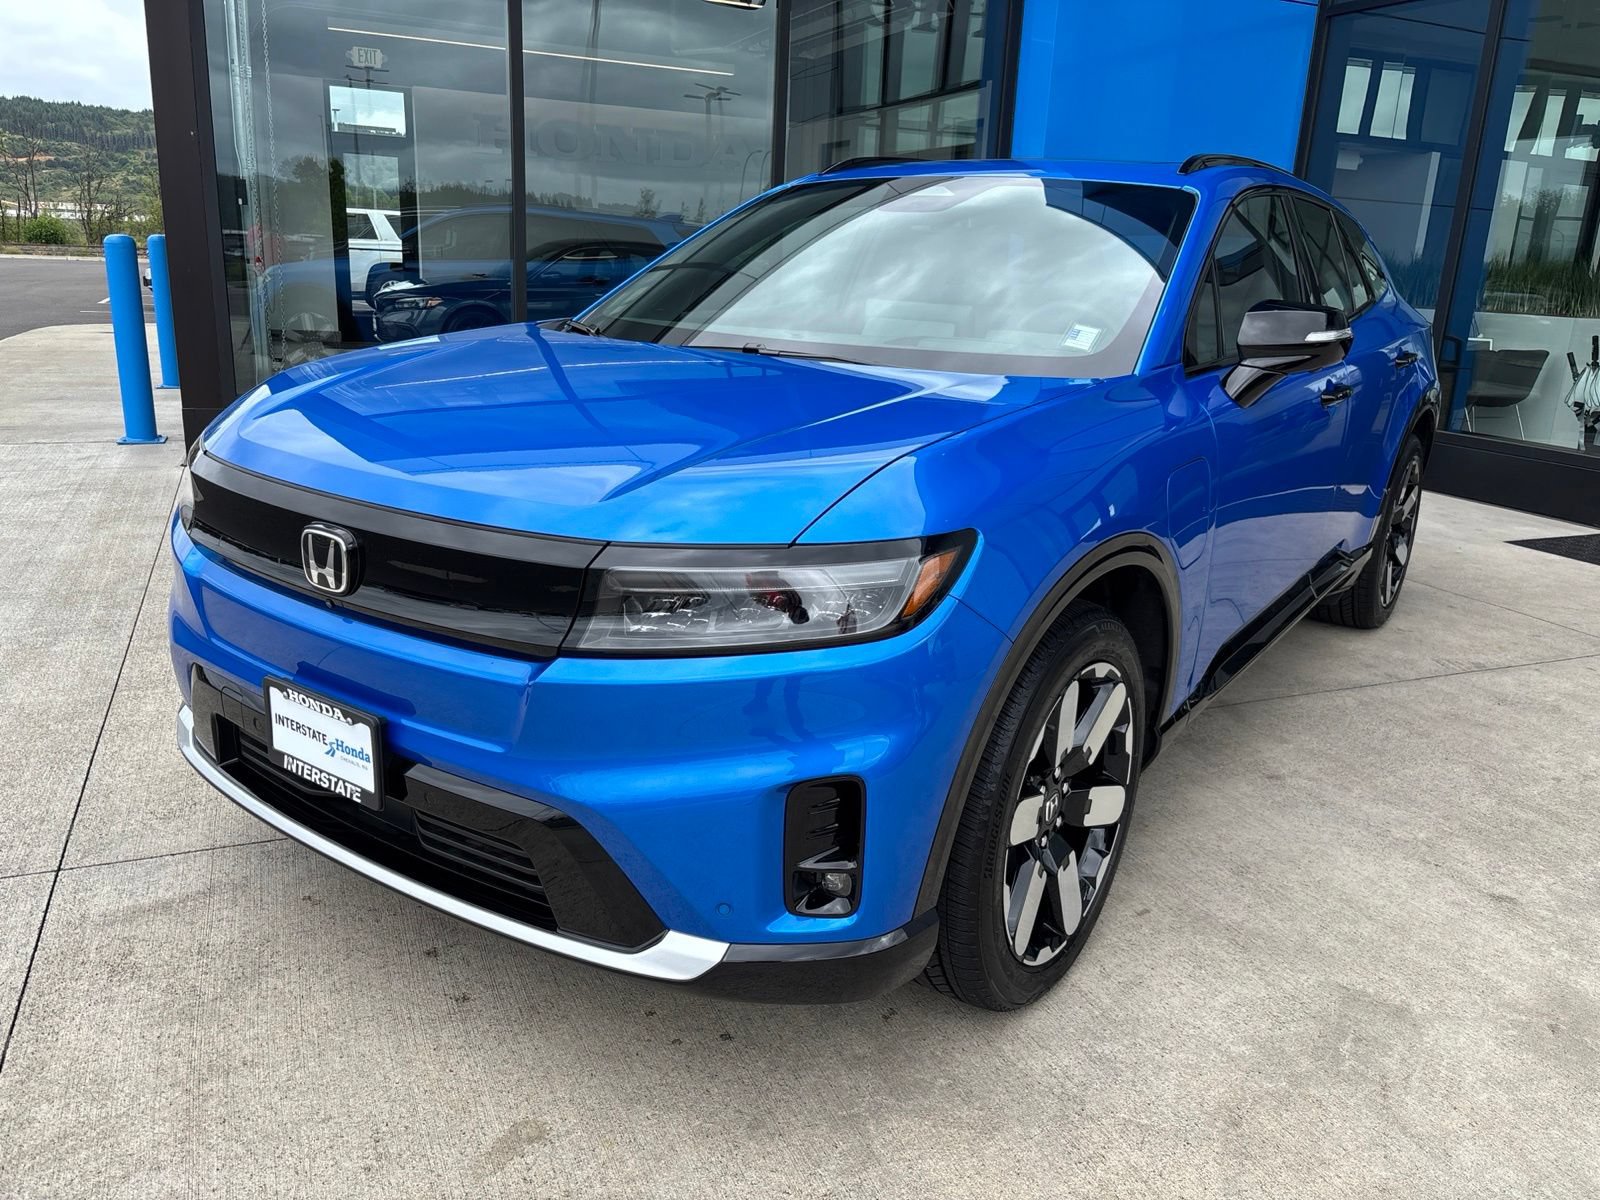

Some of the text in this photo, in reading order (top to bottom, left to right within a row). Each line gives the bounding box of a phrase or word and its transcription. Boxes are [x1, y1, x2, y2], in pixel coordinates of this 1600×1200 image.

[357, 48, 377, 65] EXIT
[473, 112, 764, 172] HONDA
[287, 688, 346, 721] HONDA
[275, 713, 328, 746] INTERSTATE
[335, 738, 371, 764] Honda
[283, 755, 362, 803] INTERSTATE
[984, 772, 1012, 880] BRIDGESTONE
